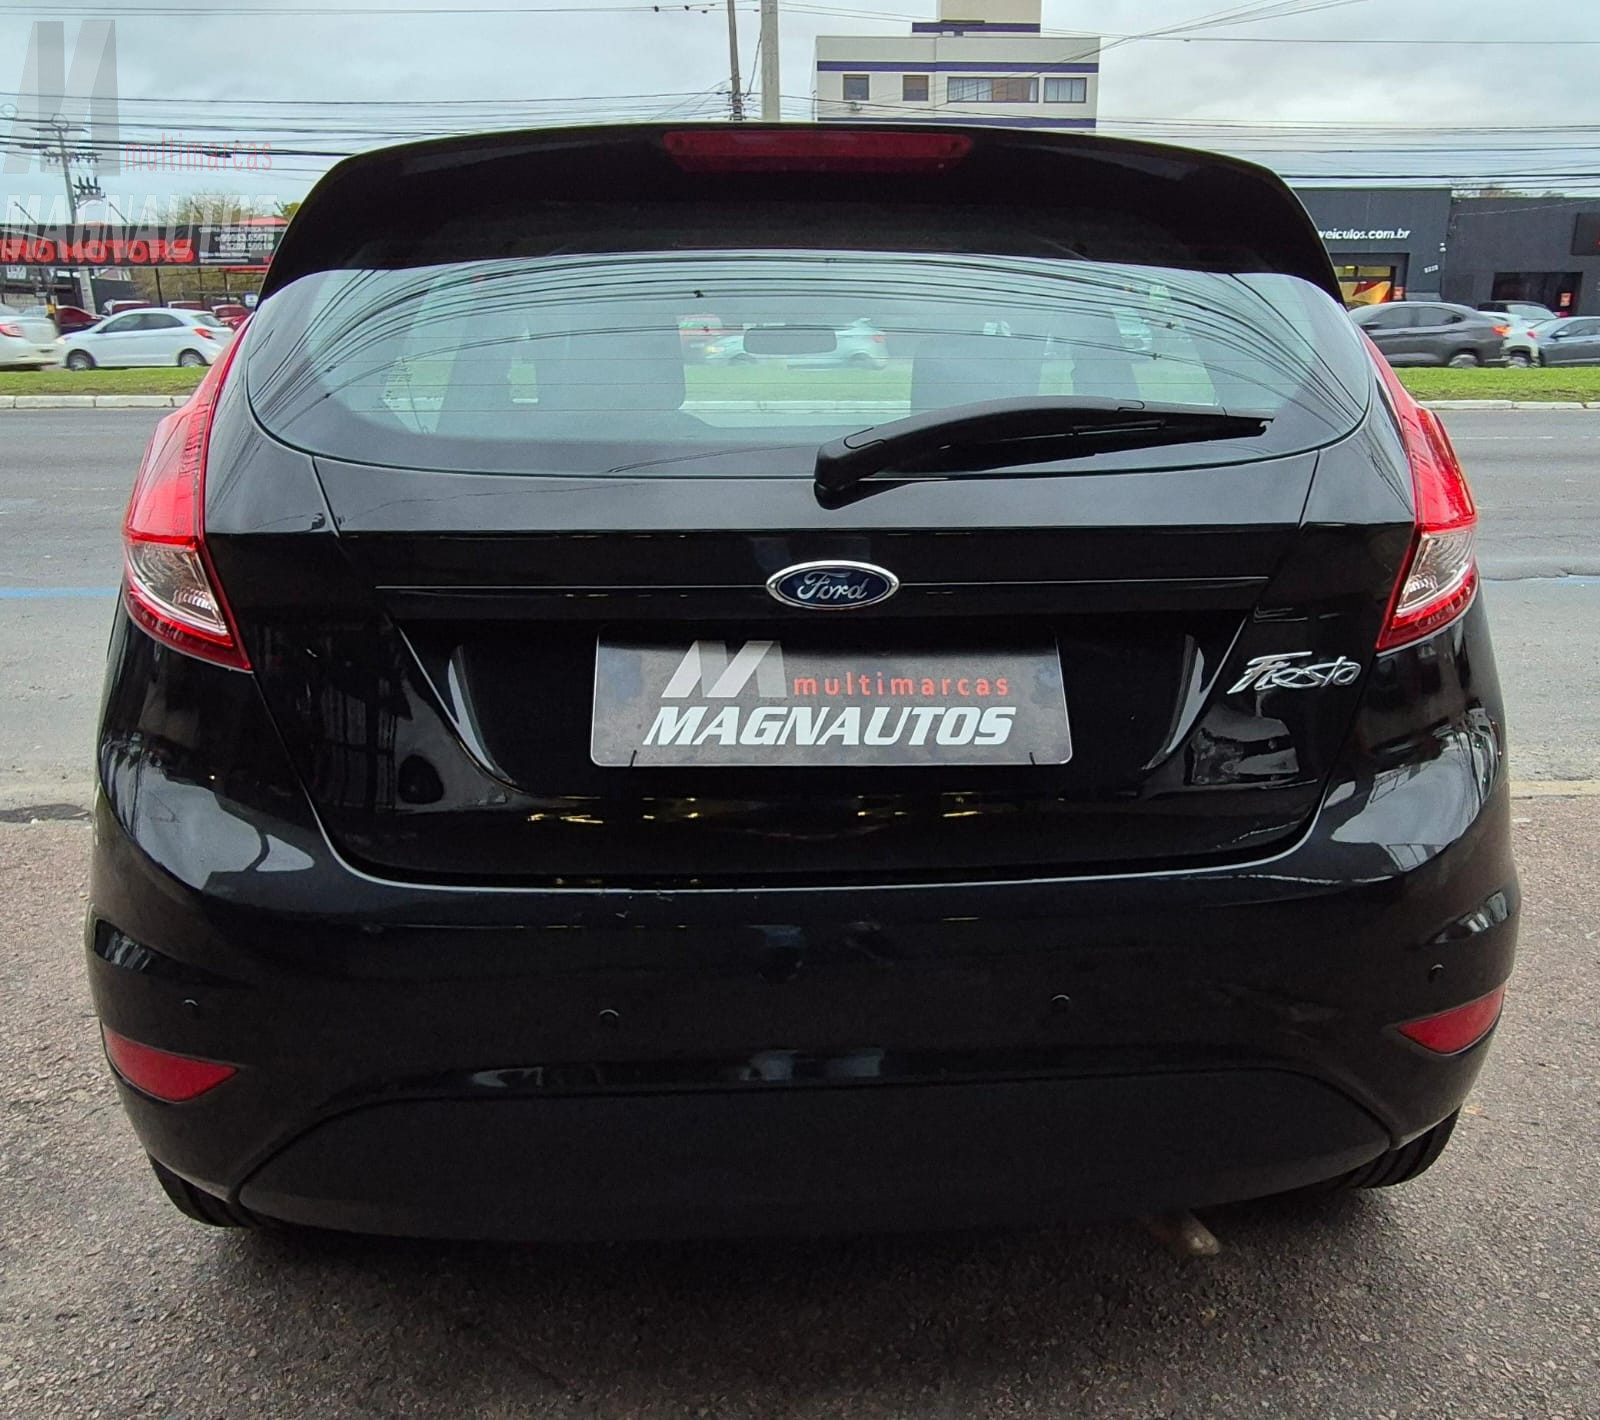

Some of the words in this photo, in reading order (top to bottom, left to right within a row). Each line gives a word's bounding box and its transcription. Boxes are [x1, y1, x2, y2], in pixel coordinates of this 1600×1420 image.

[58, 239, 195, 264] MOTORS
[796, 571, 868, 600] Ford
[793, 672, 1010, 696] multimarcas
[1226, 650, 1362, 695] Fiesta
[642, 706, 1016, 746] MAGNAUTOS
